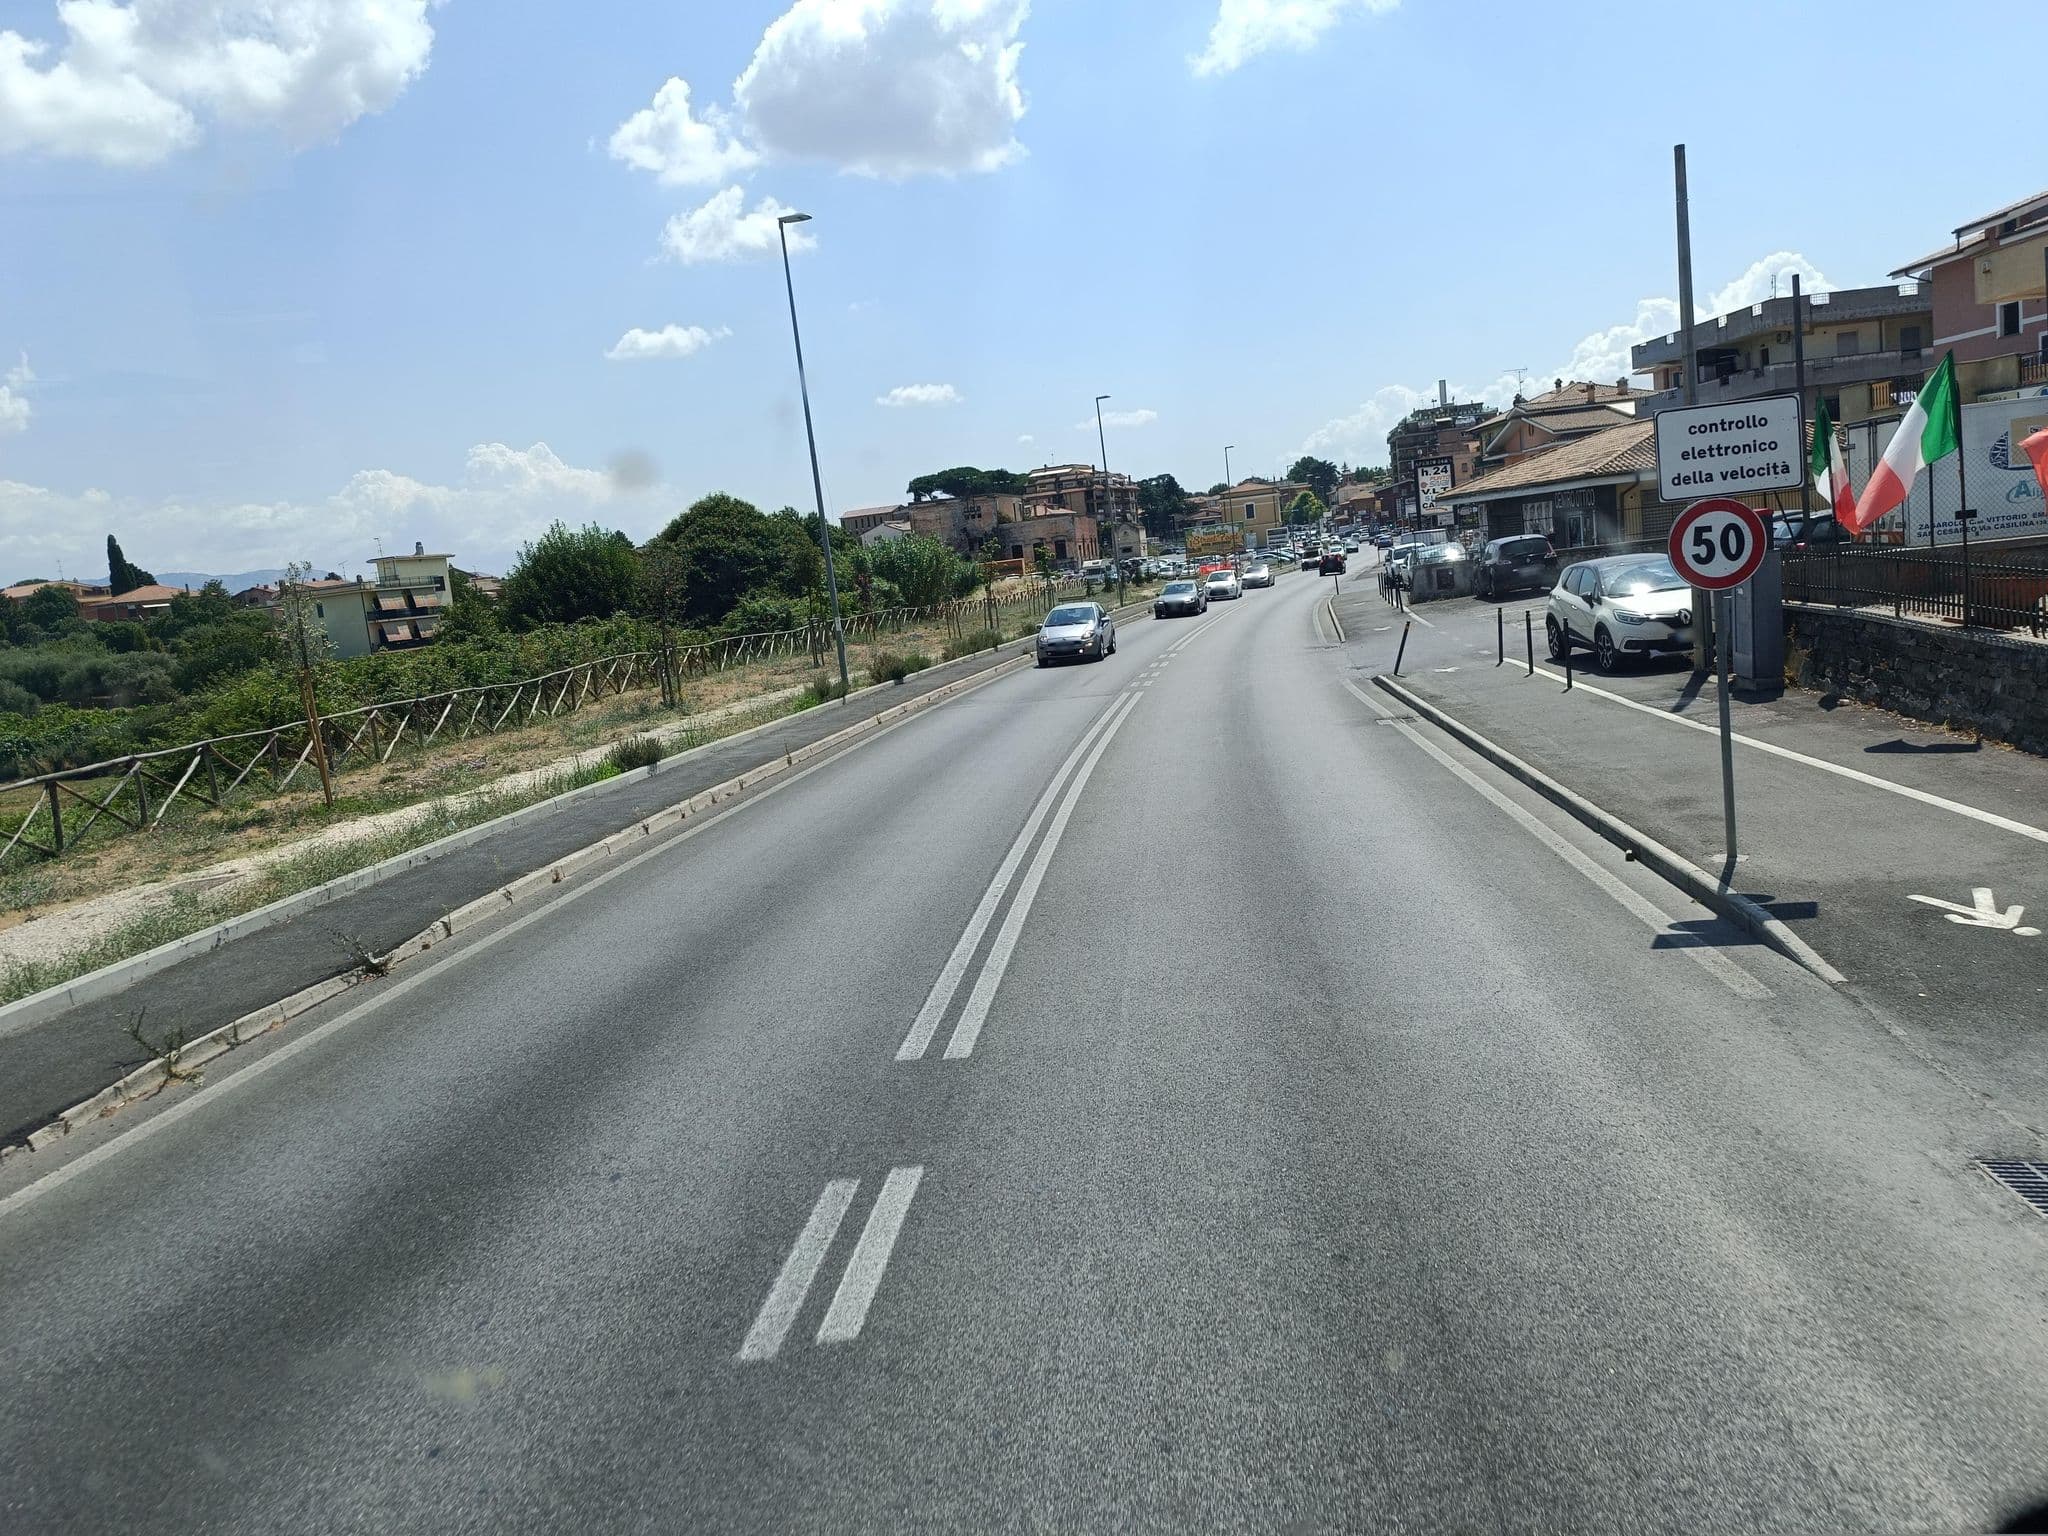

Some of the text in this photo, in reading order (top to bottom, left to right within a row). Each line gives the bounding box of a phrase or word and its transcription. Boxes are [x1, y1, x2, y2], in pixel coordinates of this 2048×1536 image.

[1688, 415, 1769, 435] controllo
[1681, 439, 1779, 460] elettronico
[1421, 466, 1448, 476] h.24
[1671, 461, 1791, 487] della velocità
[1918, 520, 1964, 530] ZAAROLO
[1986, 513, 2028, 523] VITTORIO
[2032, 511, 2047, 519] EM
[1993, 520, 2035, 530] CASILINA
[1691, 522, 1745, 566] 50
